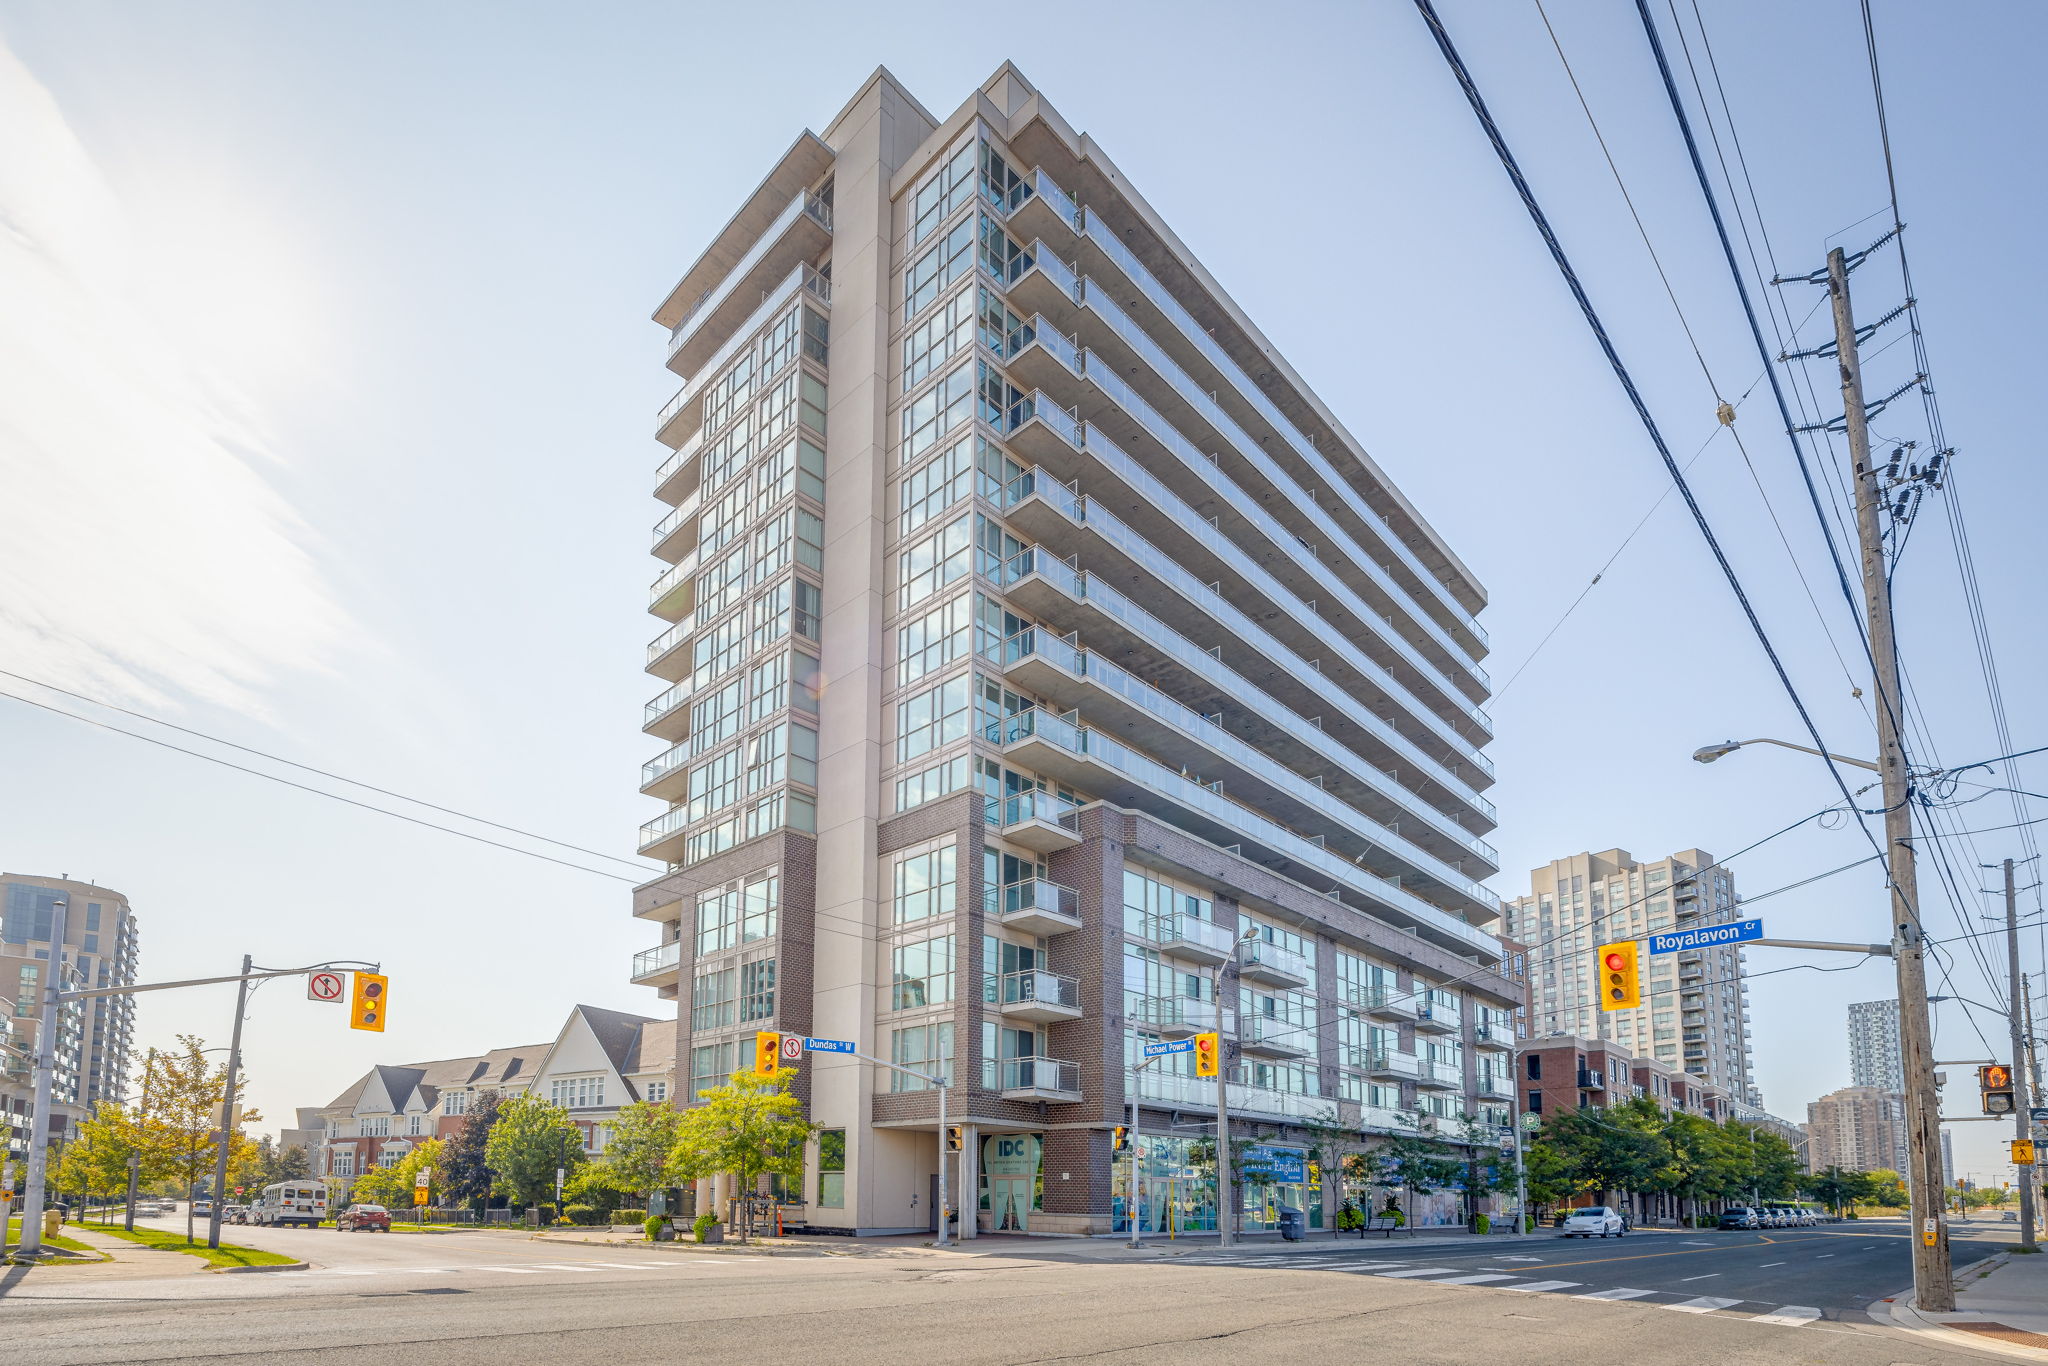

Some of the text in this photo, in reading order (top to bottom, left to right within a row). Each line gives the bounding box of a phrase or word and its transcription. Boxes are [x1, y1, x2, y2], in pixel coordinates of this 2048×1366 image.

[1655, 922, 1756, 951] Royalavon Cr
[809, 1039, 837, 1050] Dundas
[845, 1042, 852, 1051] W
[1146, 1044, 1168, 1055] Michael
[1168, 1042, 1187, 1052] Power
[1526, 1116, 1535, 1125] P
[998, 1139, 1025, 1157] IDC
[417, 1178, 428, 1186] 40
